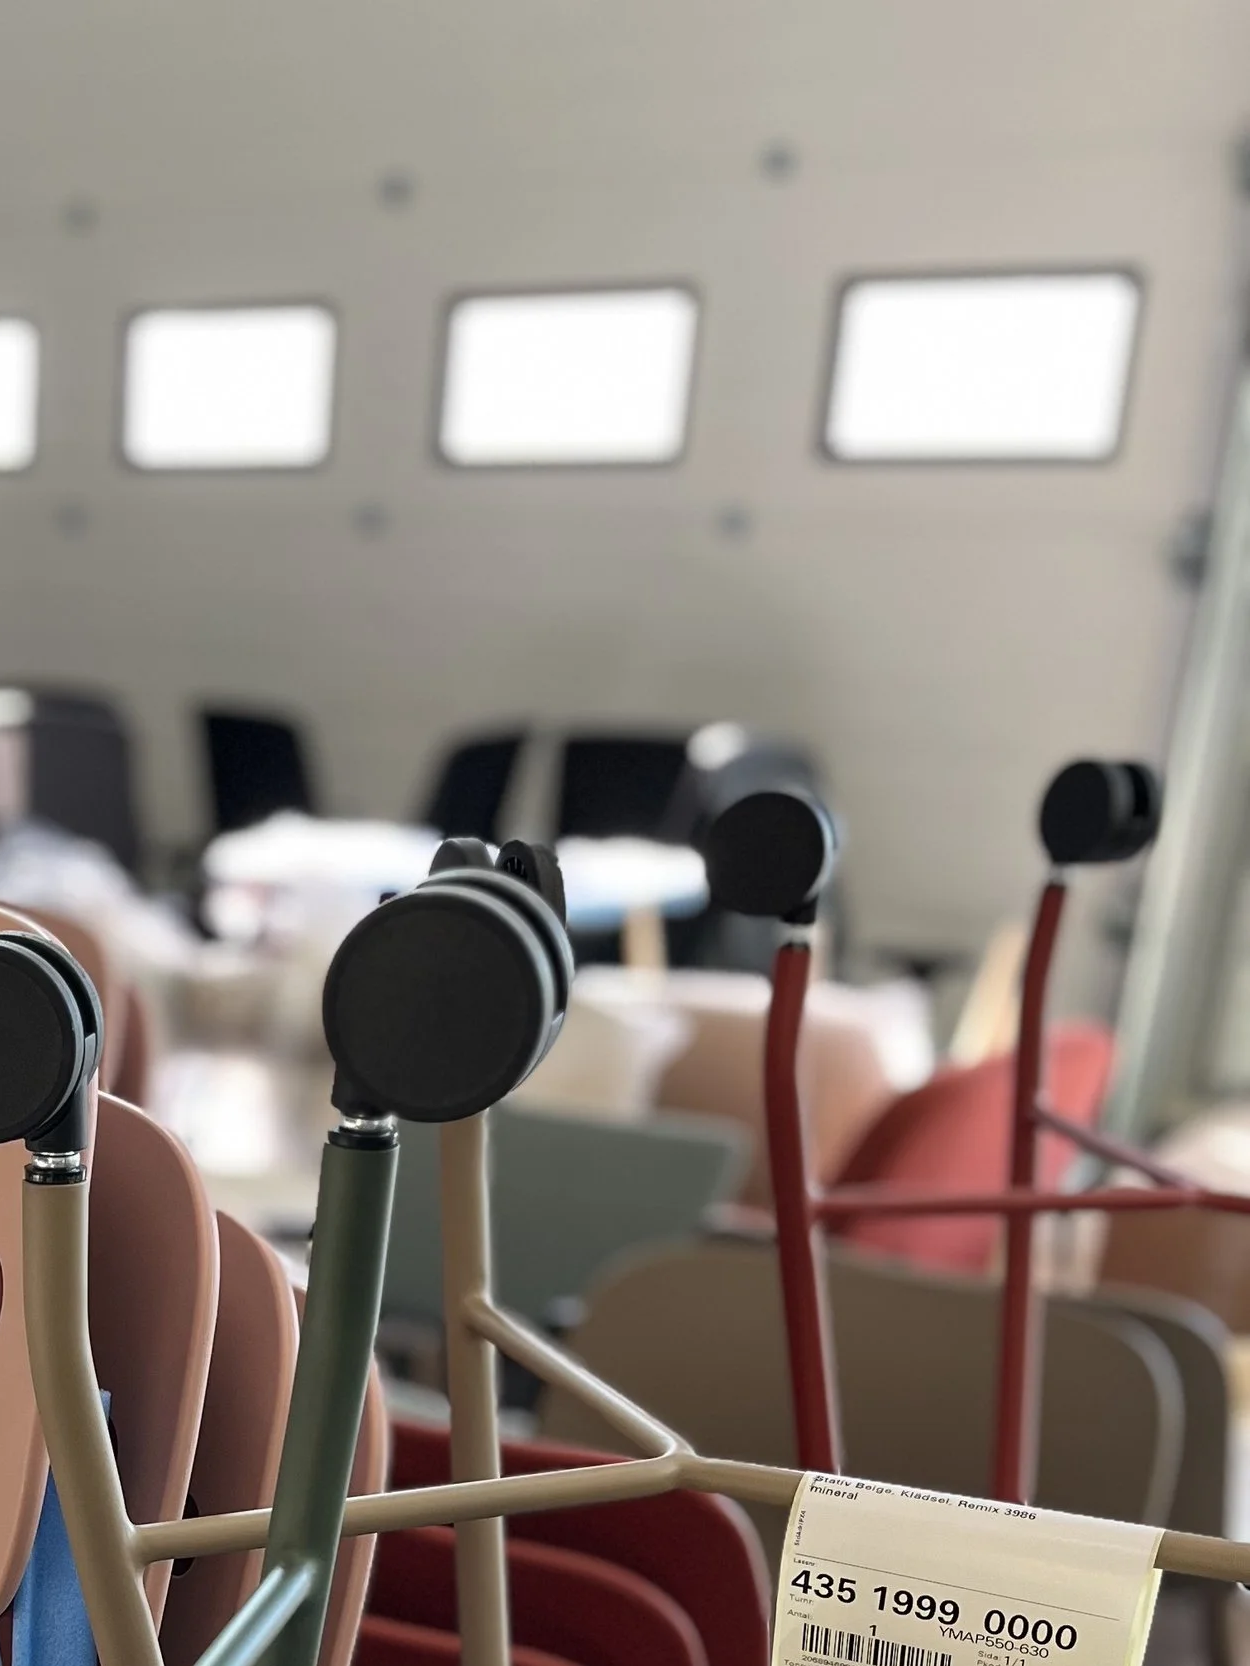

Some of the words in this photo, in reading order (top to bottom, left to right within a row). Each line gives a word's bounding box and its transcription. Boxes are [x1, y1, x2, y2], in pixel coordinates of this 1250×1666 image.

[810, 1485, 859, 1500] mineral
[813, 1475, 851, 1487] Stativ
[957, 1500, 1000, 1514] Remix
[1004, 1508, 1037, 1521] 3986
[790, 1570, 857, 1604] 435
[872, 1585, 960, 1626] 1999
[984, 1609, 1078, 1650] 0000
[869, 1624, 878, 1637] 1
[939, 1626, 1049, 1659] YMAP550-630
